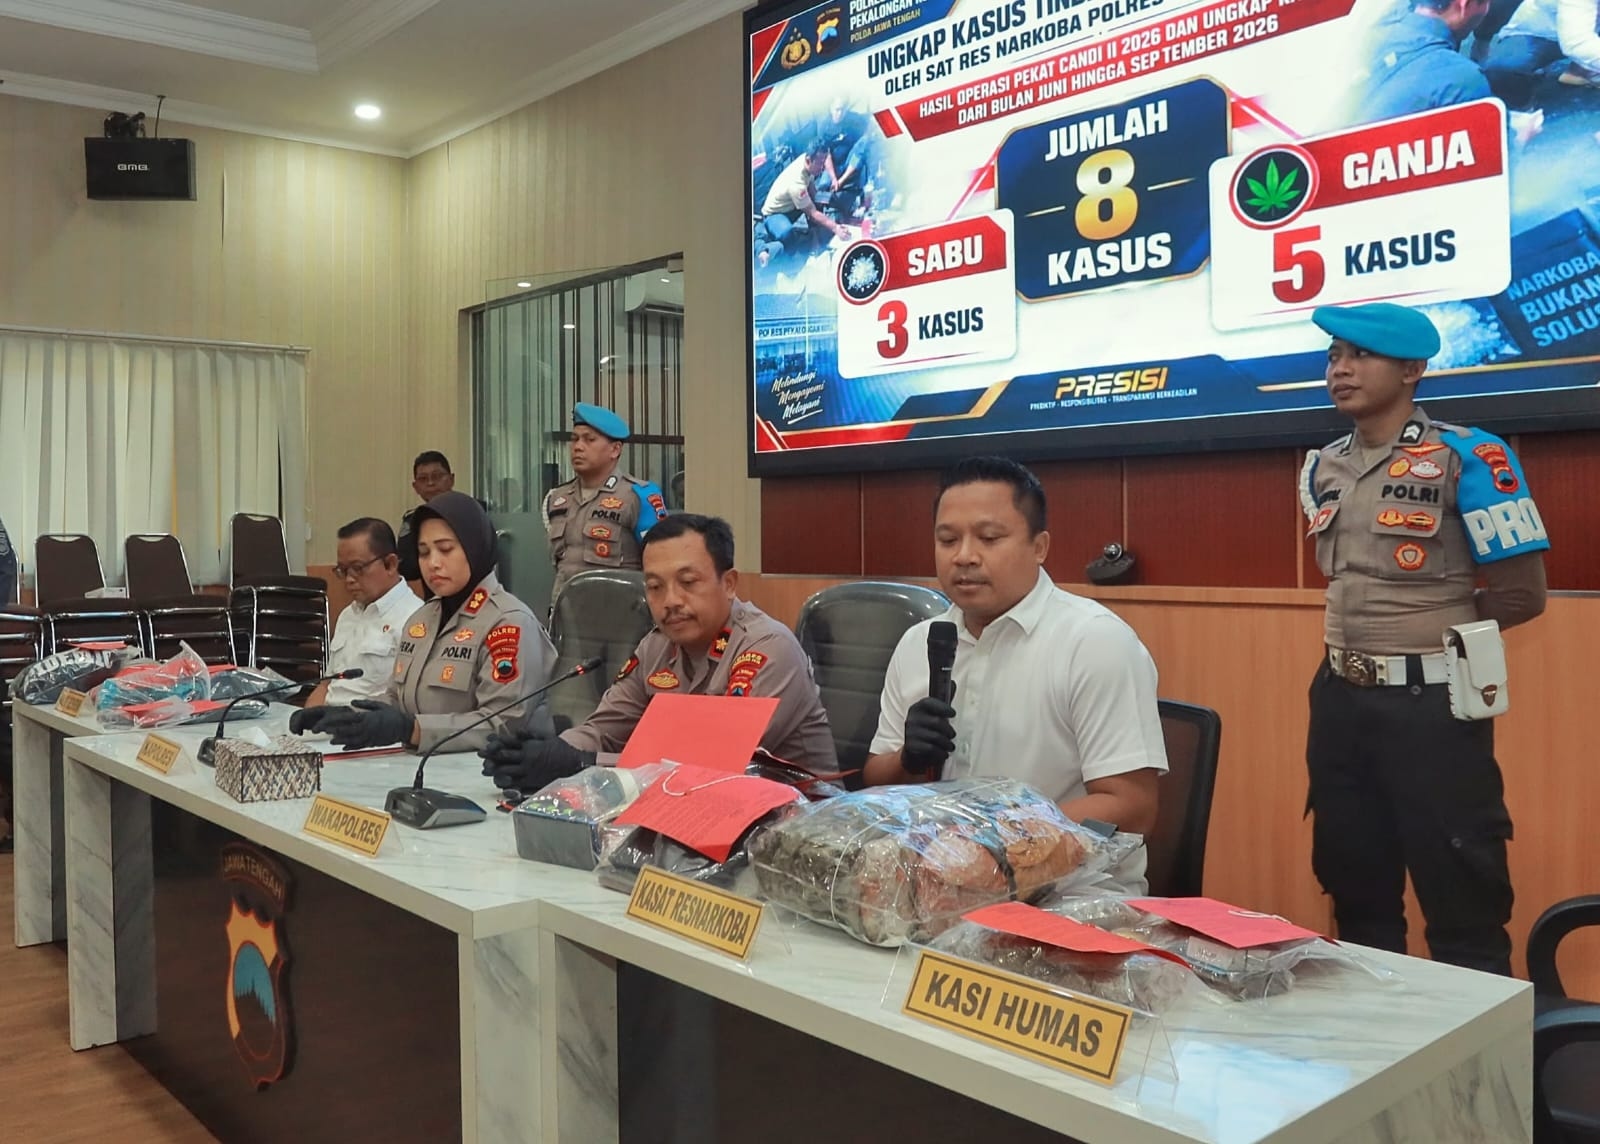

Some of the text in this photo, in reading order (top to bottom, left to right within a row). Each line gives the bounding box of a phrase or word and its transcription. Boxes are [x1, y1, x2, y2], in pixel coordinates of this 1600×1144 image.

[850, 8, 921, 43] POLDA JAWA TENGAH
[868, 1, 1026, 78] UNGKAP KASUS
[885, 69, 921, 95] OLEH
[926, 57, 954, 82] SAT
[960, 45, 990, 70] RES
[996, 14, 1082, 58] NARKOBA
[919, 0, 1272, 118] HASIL OPERASI PEKAT CANDI II 2026 DAN UNGKAP
[958, 103, 987, 125] DARI
[991, 89, 1033, 115] BULAN
[1037, 77, 1067, 101] JUNI
[1071, 60, 1126, 91] HINGGA
[1233, 14, 1278, 43] 2026
[1045, 99, 1168, 161] JUMLAH
[1343, 130, 1475, 190] GANJA
[1075, 149, 1138, 240] 8
[908, 235, 983, 277] SABU
[1047, 232, 1172, 286] KASUS
[1272, 225, 1455, 303] 5 KASUS
[1507, 251, 1600, 300] NARKOBA
[1520, 275, 1600, 323] BUKAN
[877, 300, 984, 359] 3 KASUS
[771, 368, 818, 393] Melindungi
[776, 380, 826, 406] Mengayomi
[1055, 367, 1169, 399] PRESISI
[782, 396, 821, 420] Melayani
[591, 509, 620, 521] POLRI
[1382, 484, 1439, 503] POLRI
[441, 646, 472, 659] POLRI
[311, 803, 382, 845] WAKAPOLRES
[635, 880, 751, 945] KASAT RESNARKOBA
[924, 971, 1103, 1058] KASI HUMAS
